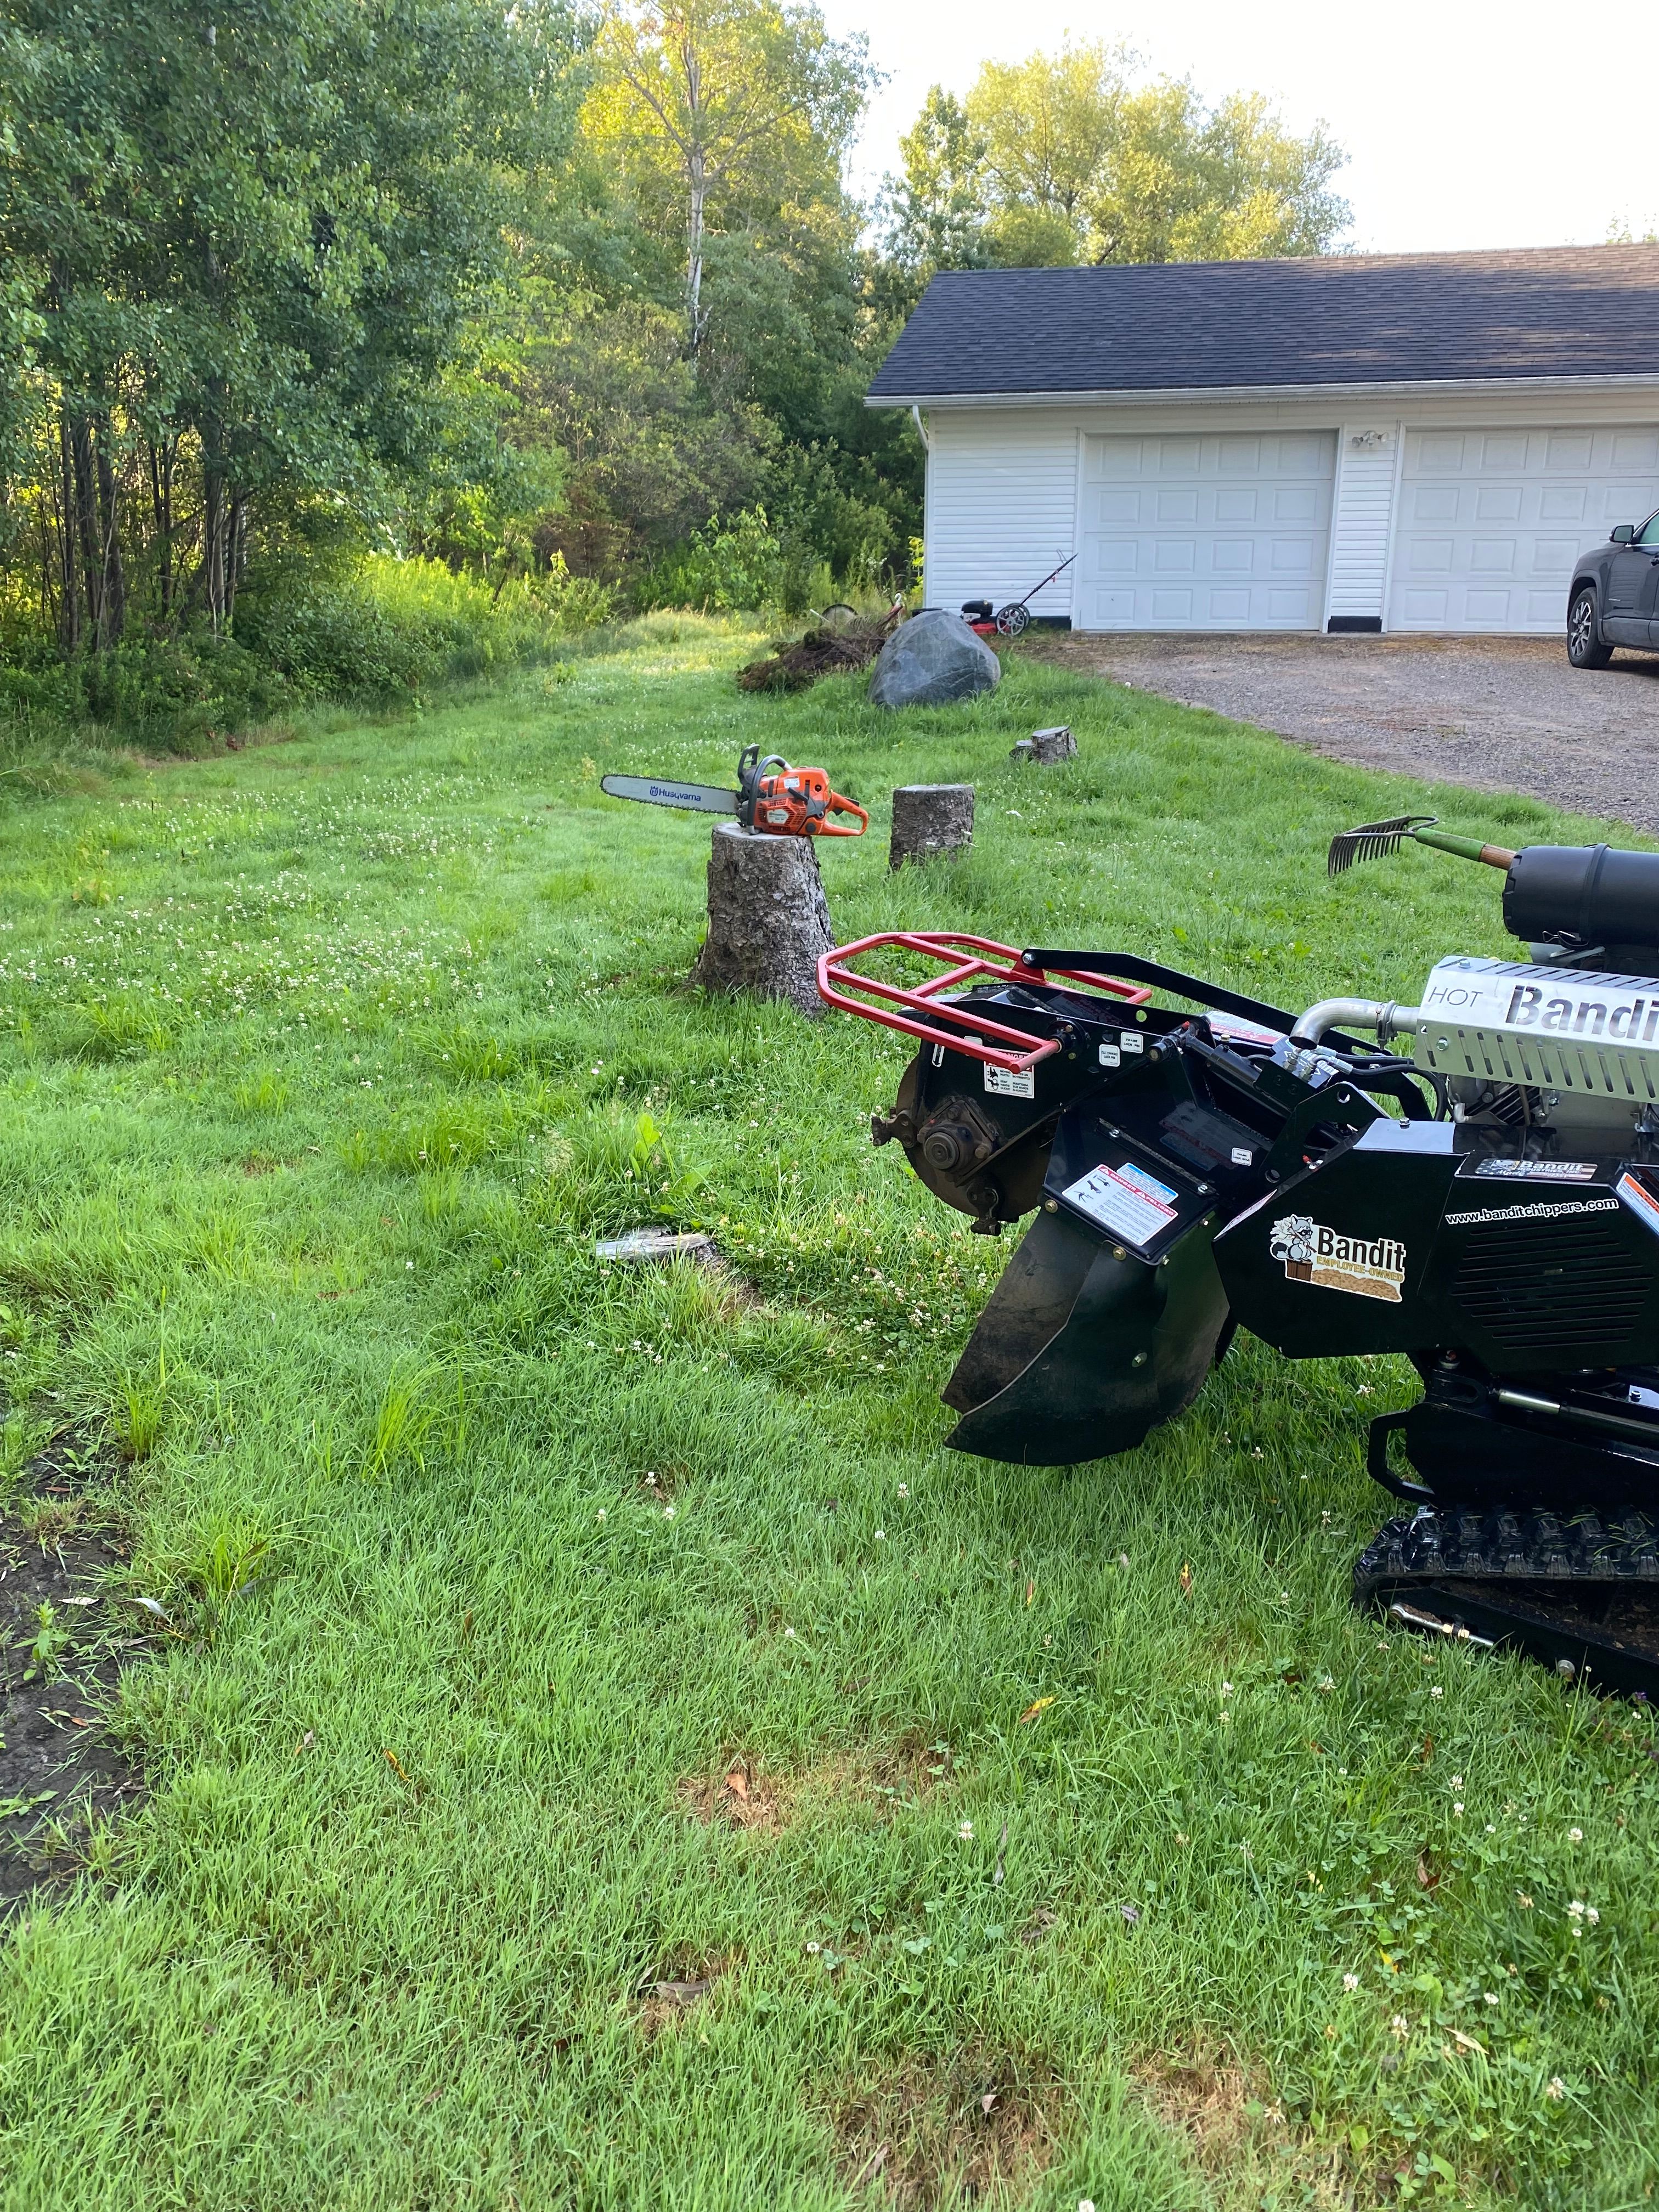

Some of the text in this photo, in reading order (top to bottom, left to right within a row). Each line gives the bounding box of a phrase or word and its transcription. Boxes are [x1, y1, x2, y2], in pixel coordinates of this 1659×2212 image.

[659, 788, 701, 802] Husqvarna
[1428, 986, 1483, 1007] HOT
[1520, 1161, 1583, 1171] Bandit
[1109, 1173, 1137, 1192] DANGER
[1145, 1196, 1174, 1216] PELIGRO
[1446, 1198, 1618, 1224] www.banditchippers.com
[1318, 1227, 1404, 1272] Bandit
[1317, 1256, 1403, 1282] EMPLOYEE-OWNED
